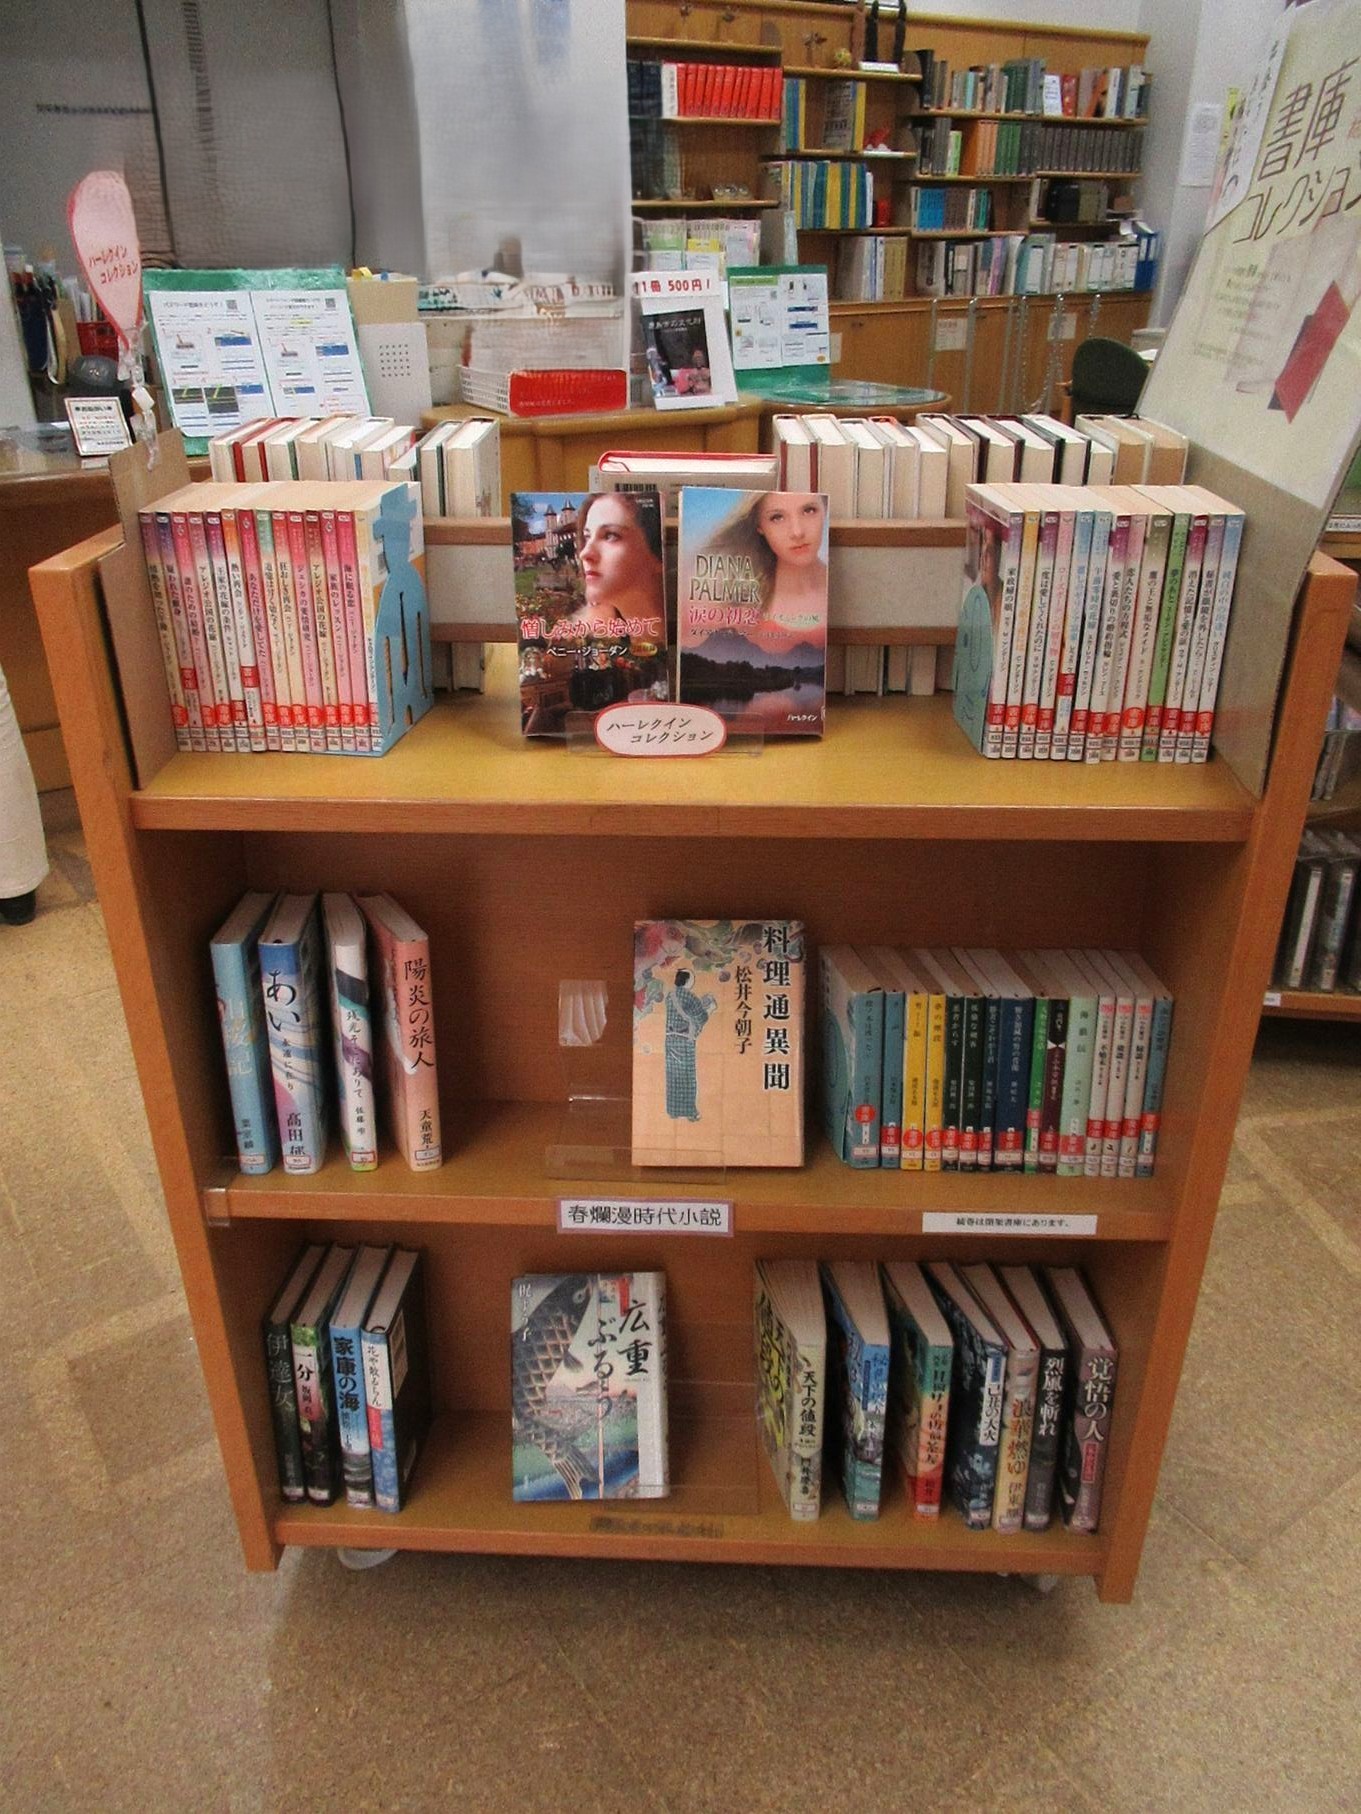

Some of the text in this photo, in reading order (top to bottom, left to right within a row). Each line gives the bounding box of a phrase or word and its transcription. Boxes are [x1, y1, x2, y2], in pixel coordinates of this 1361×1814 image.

[1258, 56, 1360, 181] 書庫
[88, 245, 128, 267] ハーレクイン
[100, 262, 140, 284] コレクション
[689, 579, 760, 603] PALMER
[696, 555, 752, 577] DIANA
[520, 616, 660, 639] 憎しみから始めて
[689, 606, 760, 626] 涙の初恋
[546, 645, 627, 658] ペニー・ジョーダン
[607, 717, 692, 731] ハーレクイン
[630, 730, 714, 745] コレクション
[787, 714, 818, 722] ハーレクイン
[266, 970, 300, 1031] あい
[404, 959, 434, 1069] 陽炎の旅人
[735, 965, 752, 1055] 松井今朝子
[763, 926, 791, 1090] 料理通異聞
[568, 1205, 722, 1227] 春爛漫時代小説
[957, 1217, 1070, 1228] 続巻は閉架書庫にあります。
[518, 1284, 533, 1342] 梶よう子
[618, 1299, 652, 1376] 広重
[266, 1333, 293, 1408] 伊達女
[296, 1352, 315, 1381] 一分
[333, 1336, 360, 1412] 家康の海
[588, 1317, 618, 1420] ぶるう
[798, 1371, 817, 1437] 天下の値段
[1038, 1356, 1064, 1436] 烈風を斬れ
[1084, 1357, 1114, 1441] 覚悟の人
[1008, 1399, 1033, 1476] 浪華燃ゆ
